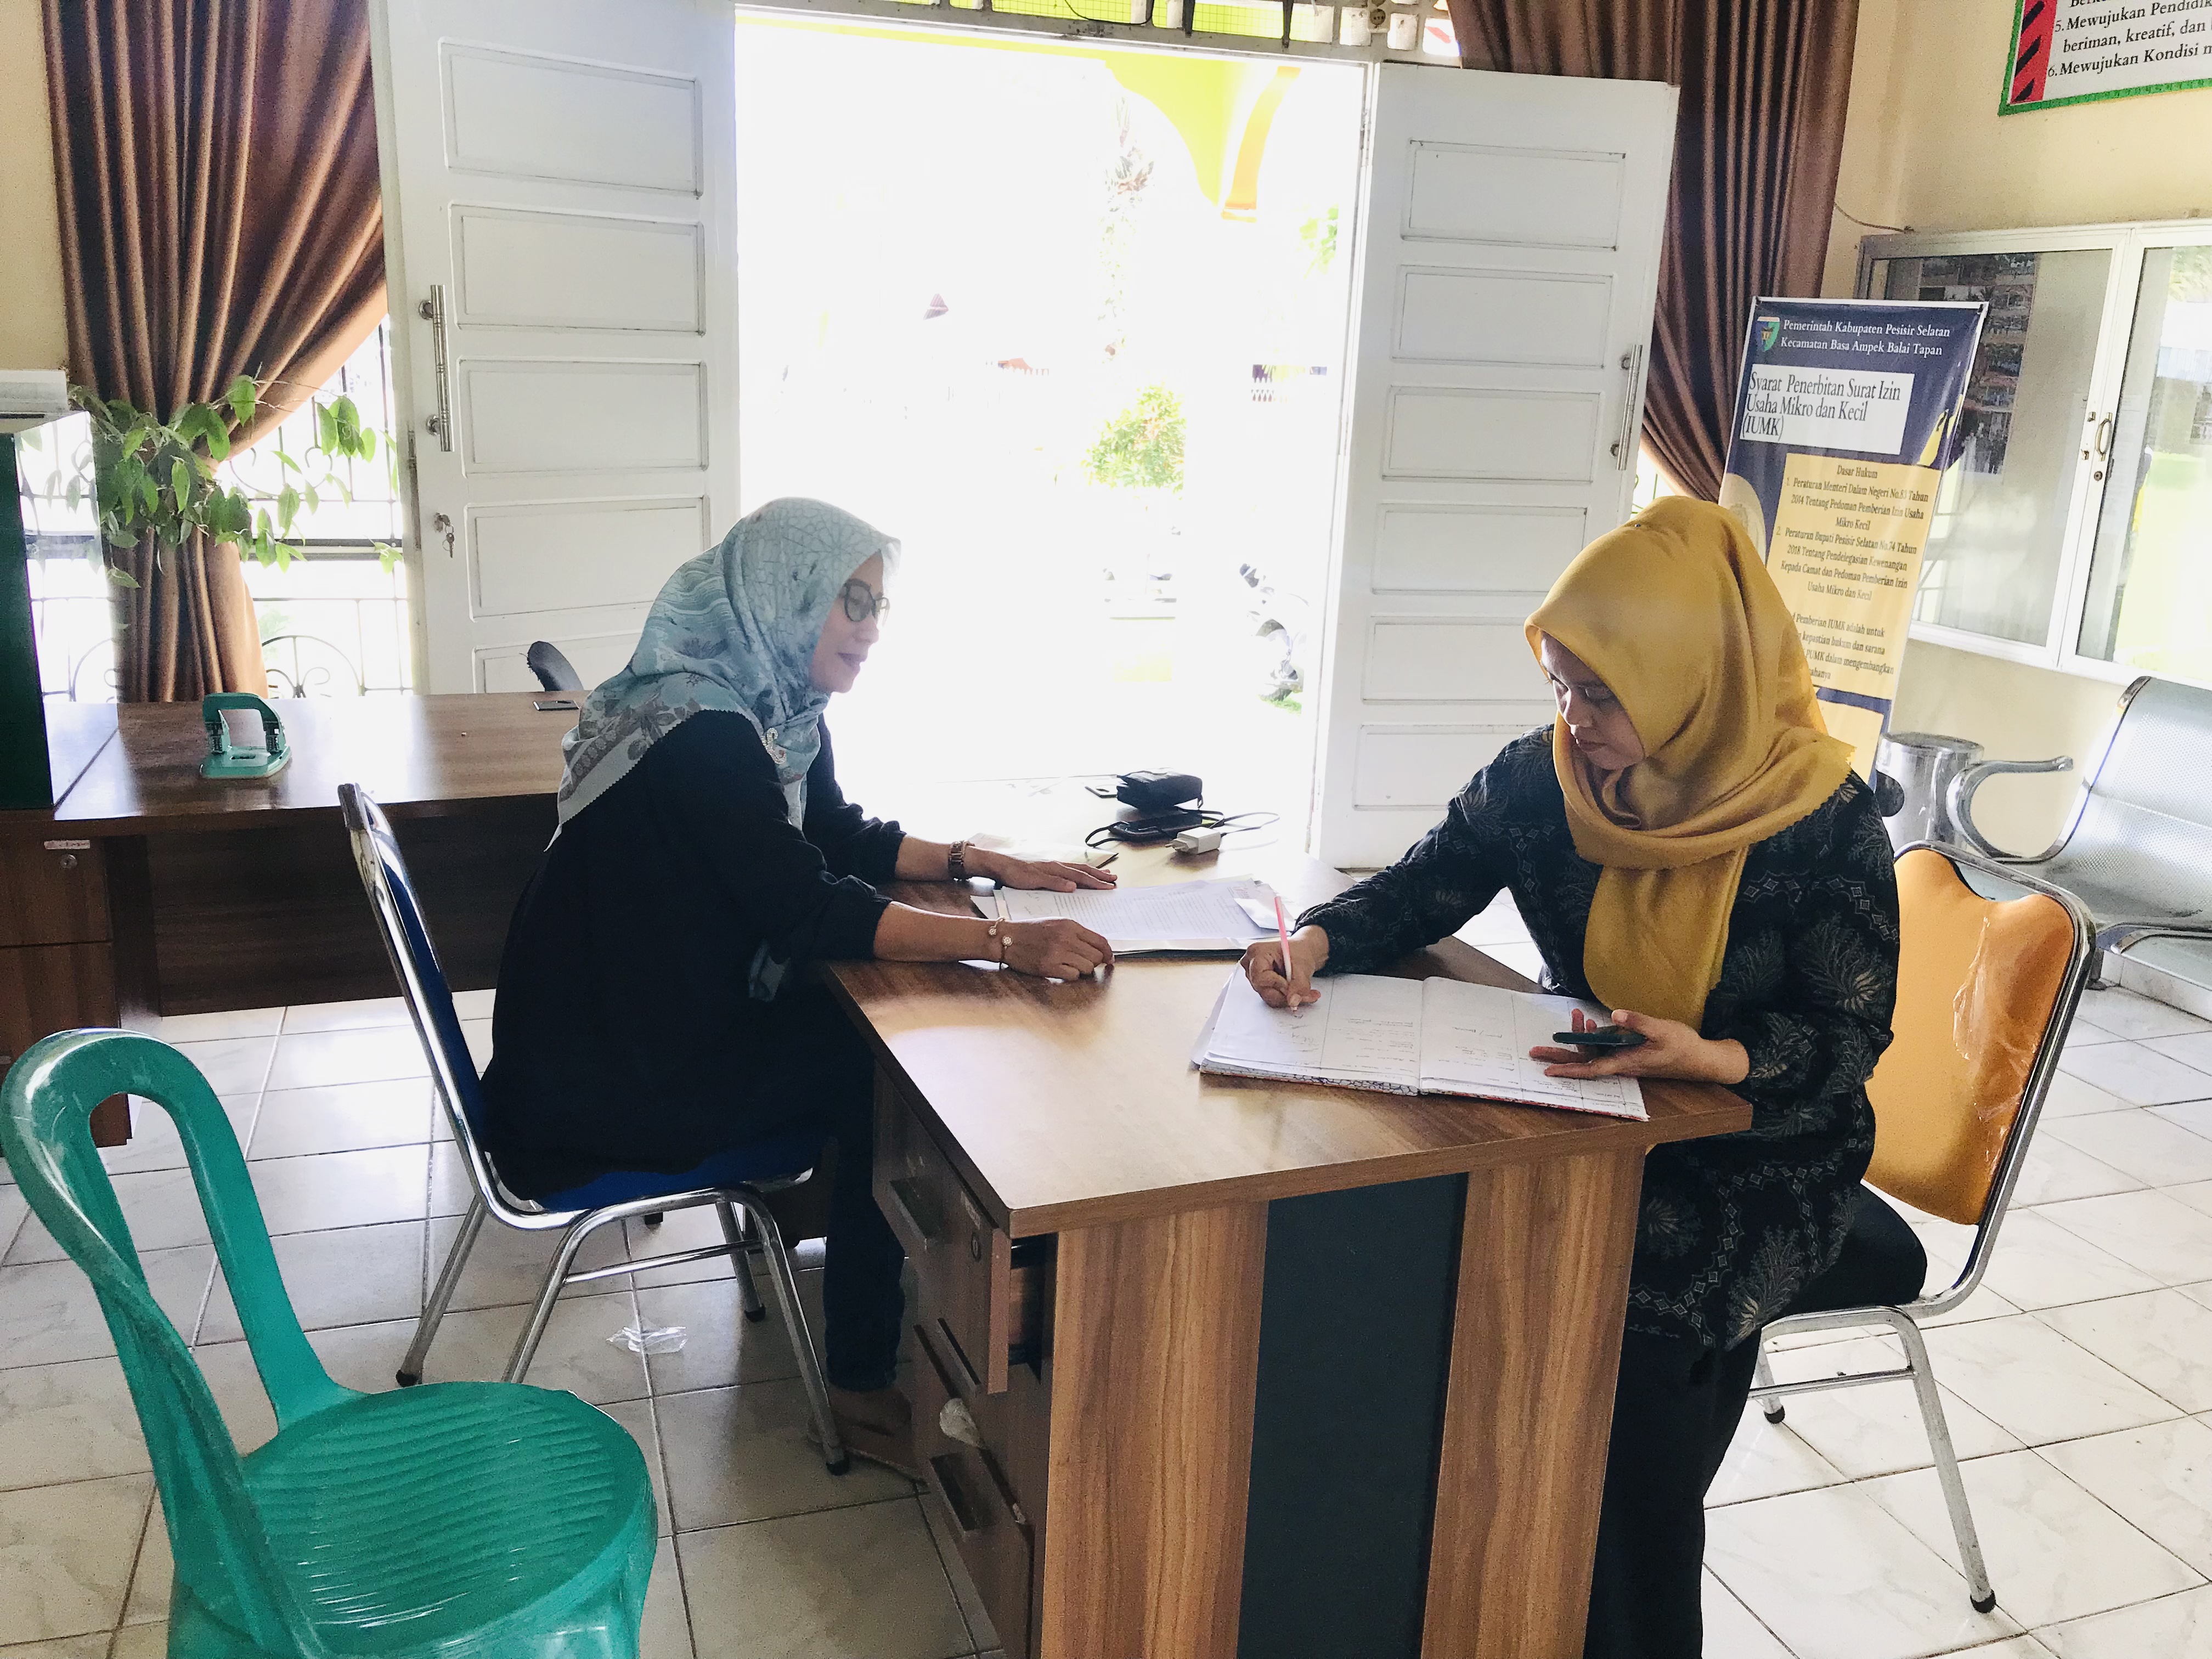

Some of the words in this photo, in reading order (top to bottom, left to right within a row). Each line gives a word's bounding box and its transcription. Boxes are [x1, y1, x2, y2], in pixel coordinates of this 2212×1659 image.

[2063, 35, 2121, 53] beriman,
[2125, 20, 2175, 43] kreatif,
[2180, 19, 2205, 35] dan
[2143, 42, 2198, 63] Kondisi
[1784, 319, 1833, 332] Pemerintah
[1835, 321, 1883, 336] Kabupaten
[1886, 325, 1915, 336] Pesisir
[1917, 325, 1950, 337] Selatan
[1781, 337, 1828, 350] Kecamatan
[1831, 339, 1849, 351] Basa
[1852, 340, 1884, 353] Ampek
[1887, 342, 1910, 354] Balai
[1914, 343, 1943, 358] Tapan
[1749, 371, 1782, 396] Syarat
[1787, 374, 1844, 396] Penerbitan
[1847, 378, 1876, 398] Surat
[1878, 380, 1901, 400] Izin
[1746, 393, 1778, 414] Usaha
[1780, 397, 1813, 416] Mikro
[1815, 398, 1836, 418] dan
[1838, 400, 1869, 422] Kecil
[1742, 413, 1784, 442] (IUMK)
[1837, 465, 1854, 476] Dasar
[1855, 467, 1878, 479] Hukum
[1793, 477, 1822, 490] Peraturan
[1823, 481, 1848, 492] Menteri
[1848, 483, 1867, 494] Dalam
[1869, 487, 1889, 500] Negeri
[1909, 490, 1928, 502] Tahun
[1791, 494, 1804, 505] 2014
[1805, 495, 1830, 510] Tentang
[1830, 499, 1857, 511] Pedoman
[1858, 502, 1891, 516] Pemberian
[1905, 507, 1924, 520] Usaha
[1835, 517, 1854, 528] Mikro
[1855, 518, 1870, 531] Kecil
[1785, 527, 1814, 540] Peraturan
[1815, 531, 1834, 545] Bupati
[1835, 534, 1855, 546] Pesisir
[1856, 537, 1878, 549] Selatan
[1897, 542, 1917, 554] Tahun
[1787, 544, 1801, 555] 2018
[1802, 546, 1826, 561] Tentang
[1826, 550, 1868, 566] Pendelegasian
[1869, 556, 1907, 573] Kewenangan
[1780, 561, 1802, 573] Kepada
[1802, 564, 1821, 575] Camat
[1822, 566, 1832, 577] dan
[1833, 568, 1861, 582] Pedoman
[1862, 572, 1894, 586] Pemberian
[1895, 577, 1908, 589] Izin
[1808, 581, 1824, 593] Usaha
[1826, 584, 1844, 596] Mikro
[1844, 587, 1856, 598] dan
[1857, 589, 1872, 601] Kecil
[1796, 613, 1827, 627] Pemberian
[1828, 619, 1846, 630] IUMK
[1846, 623, 1865, 635] adalah
[1866, 627, 1886, 637] untuk
[1802, 630, 1830, 645] kepastian
[1831, 635, 1852, 648] hukum
[1852, 640, 1864, 651] dan
[1865, 644, 1886, 655] sarana
[1825, 653, 1842, 664] dalam
[1843, 658, 1894, 675] mengembangkan
